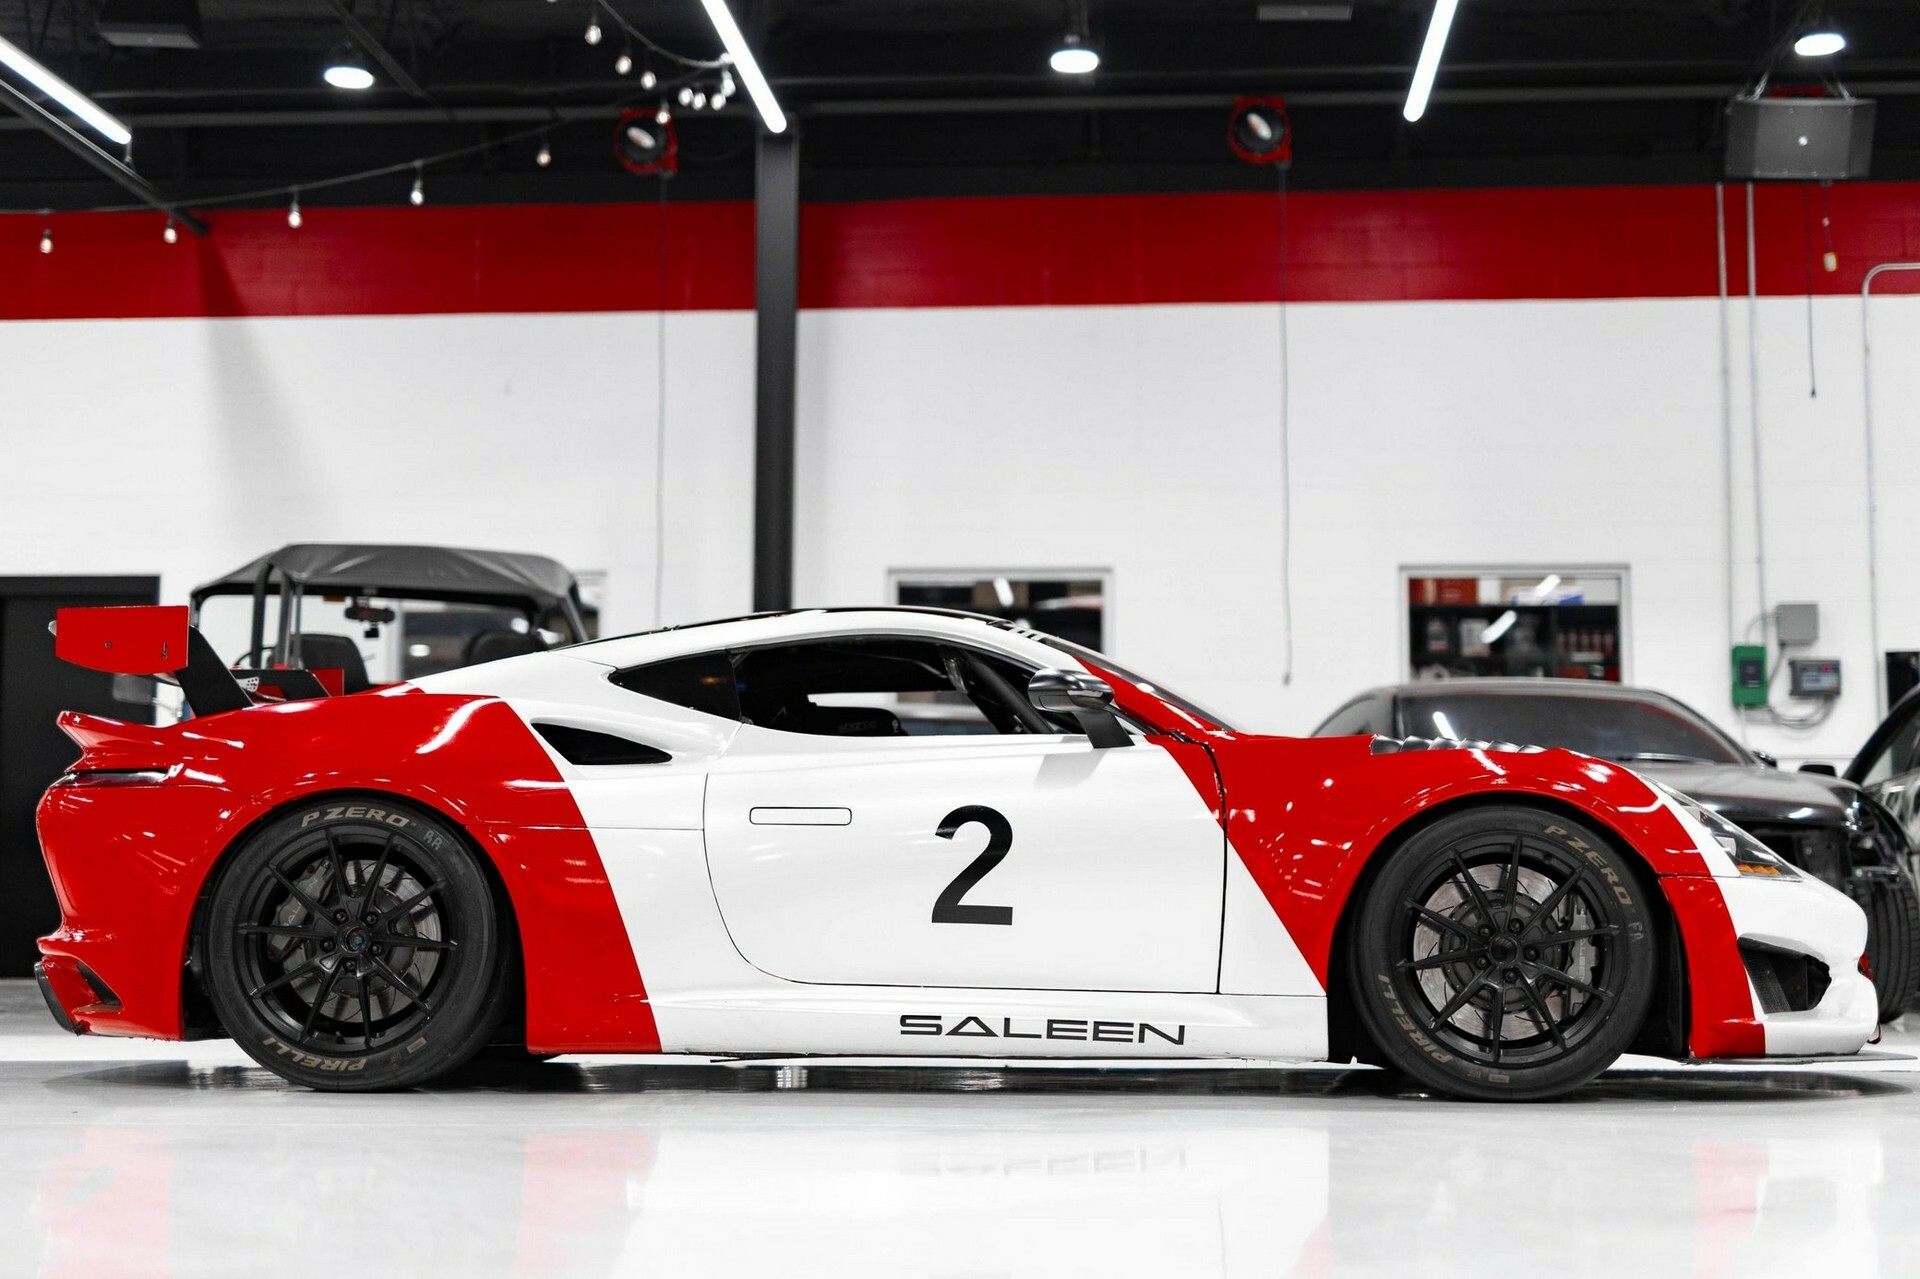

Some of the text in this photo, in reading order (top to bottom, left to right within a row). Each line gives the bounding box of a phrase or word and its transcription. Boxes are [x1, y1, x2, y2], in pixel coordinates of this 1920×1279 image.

[301, 806, 410, 828] P ZERO
[932, 805, 1014, 925] 2
[1544, 825, 1633, 905] P ZERO
[900, 1015, 1185, 1046] SALEEN
[1377, 974, 1454, 1063] PIRELLI
[262, 1037, 368, 1072] PIRELLI
